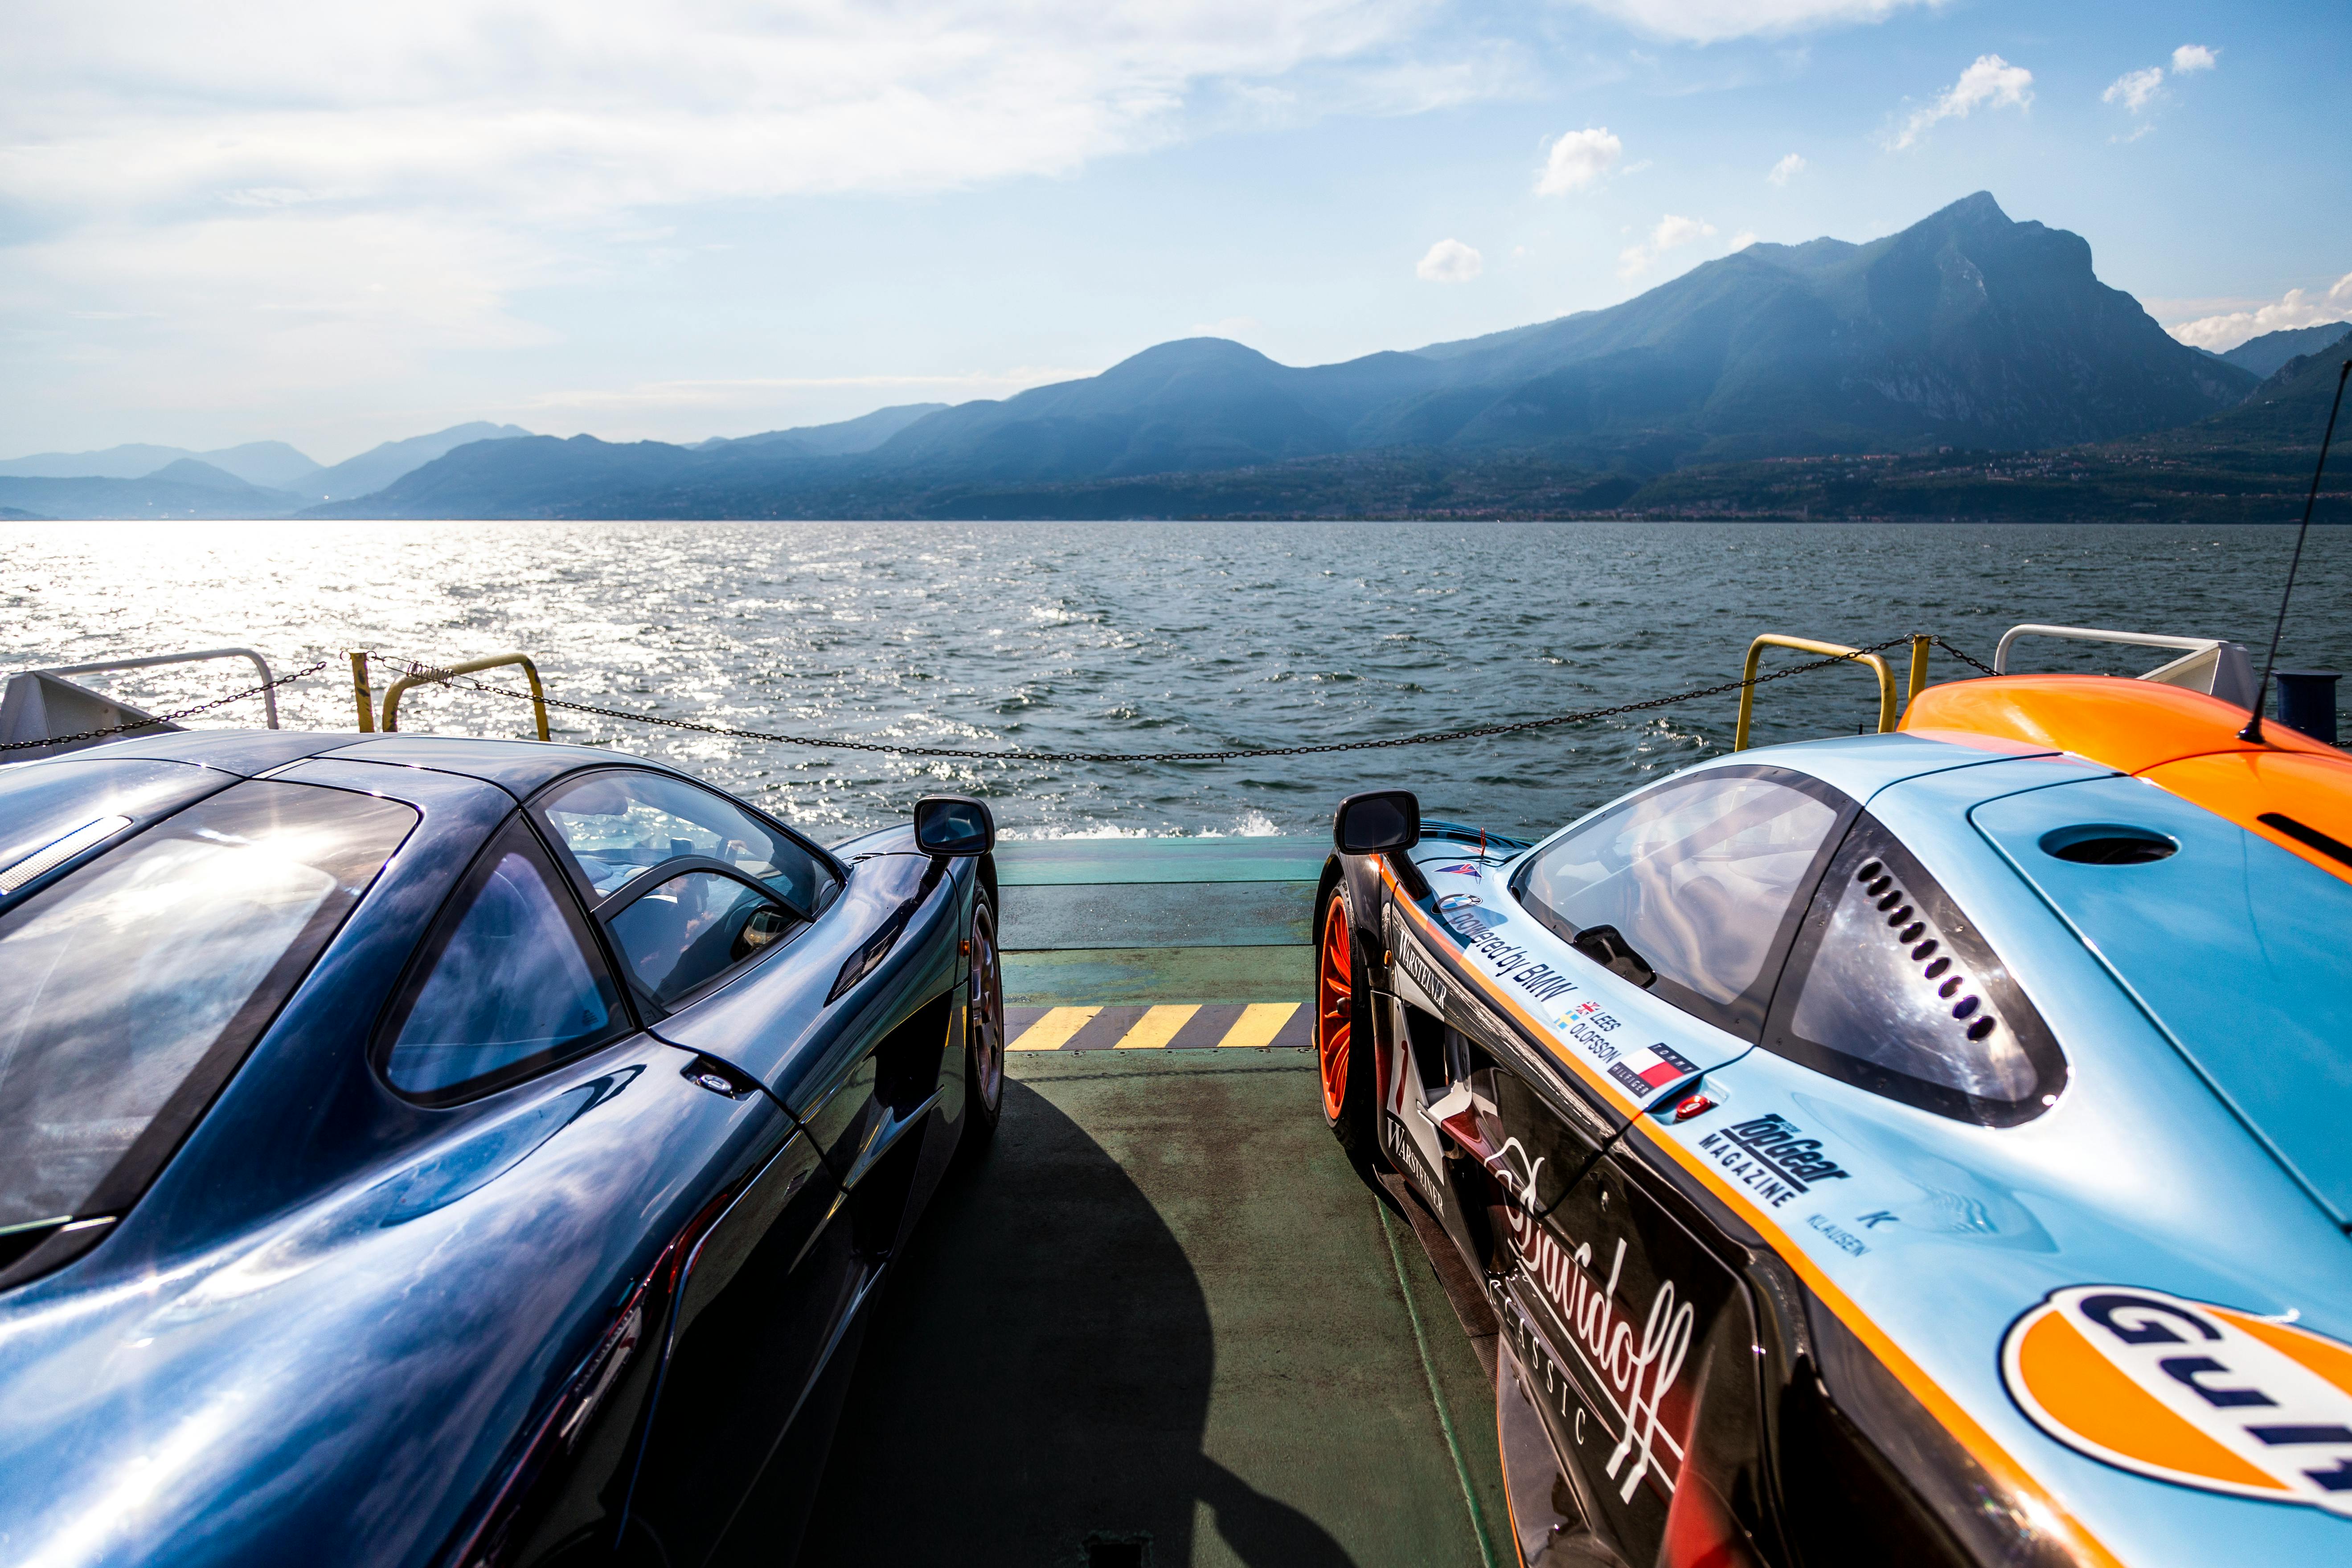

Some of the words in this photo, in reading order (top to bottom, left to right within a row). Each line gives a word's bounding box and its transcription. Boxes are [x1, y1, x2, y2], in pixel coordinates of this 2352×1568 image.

[1443, 913, 1522, 960] powered
[1399, 929, 1447, 1010] WARSTEINER
[1496, 950, 1531, 977] by
[1512, 963, 1579, 1002] BMW
[1589, 1012, 1622, 1032] LEES
[1569, 1023, 1622, 1064] OLOFSSON
[1653, 1044, 1695, 1072] TOMMY
[1612, 1064, 1649, 1094] HILFIGER
[1387, 1117, 1445, 1218] WARSTEINER
[1698, 1133, 1797, 1209] MAGAZINE
[1806, 1213, 1872, 1257] KLAUSEN
